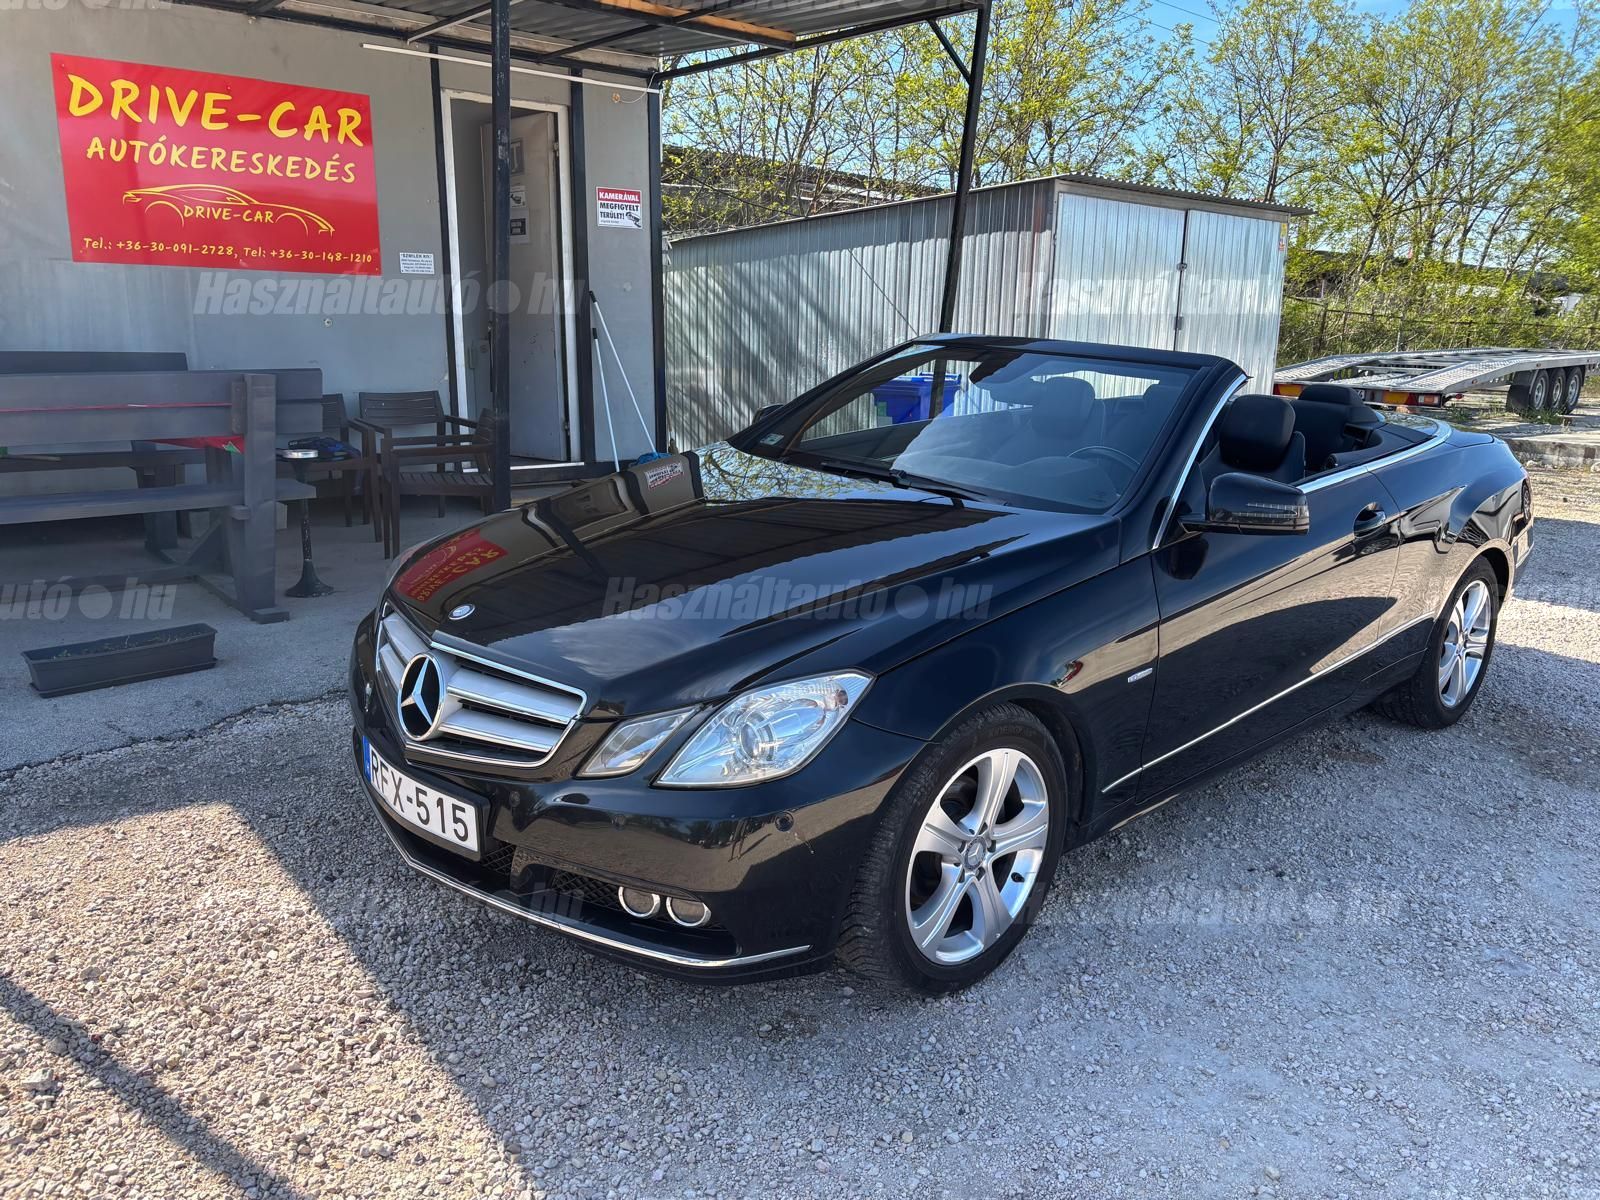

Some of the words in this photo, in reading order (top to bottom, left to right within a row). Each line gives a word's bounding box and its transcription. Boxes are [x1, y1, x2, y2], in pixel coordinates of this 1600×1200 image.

[68, 74, 364, 147] DRIVE-CAR
[86, 134, 356, 184] AUTÓKERESKEDÉS
[598, 191, 640, 202] KAMERÁVAL
[599, 202, 640, 212] MEGFIGYELT
[183, 204, 275, 224] DRIVE-CAR
[599, 211, 625, 220] TERÜLET!
[83, 237, 112, 250] Tel.:
[115, 239, 238, 259] +36-30-091-2728,
[243, 246, 267, 258] Tel:
[269, 248, 373, 264] +36-30-148-1210
[370, 748, 470, 843] RFX-515
